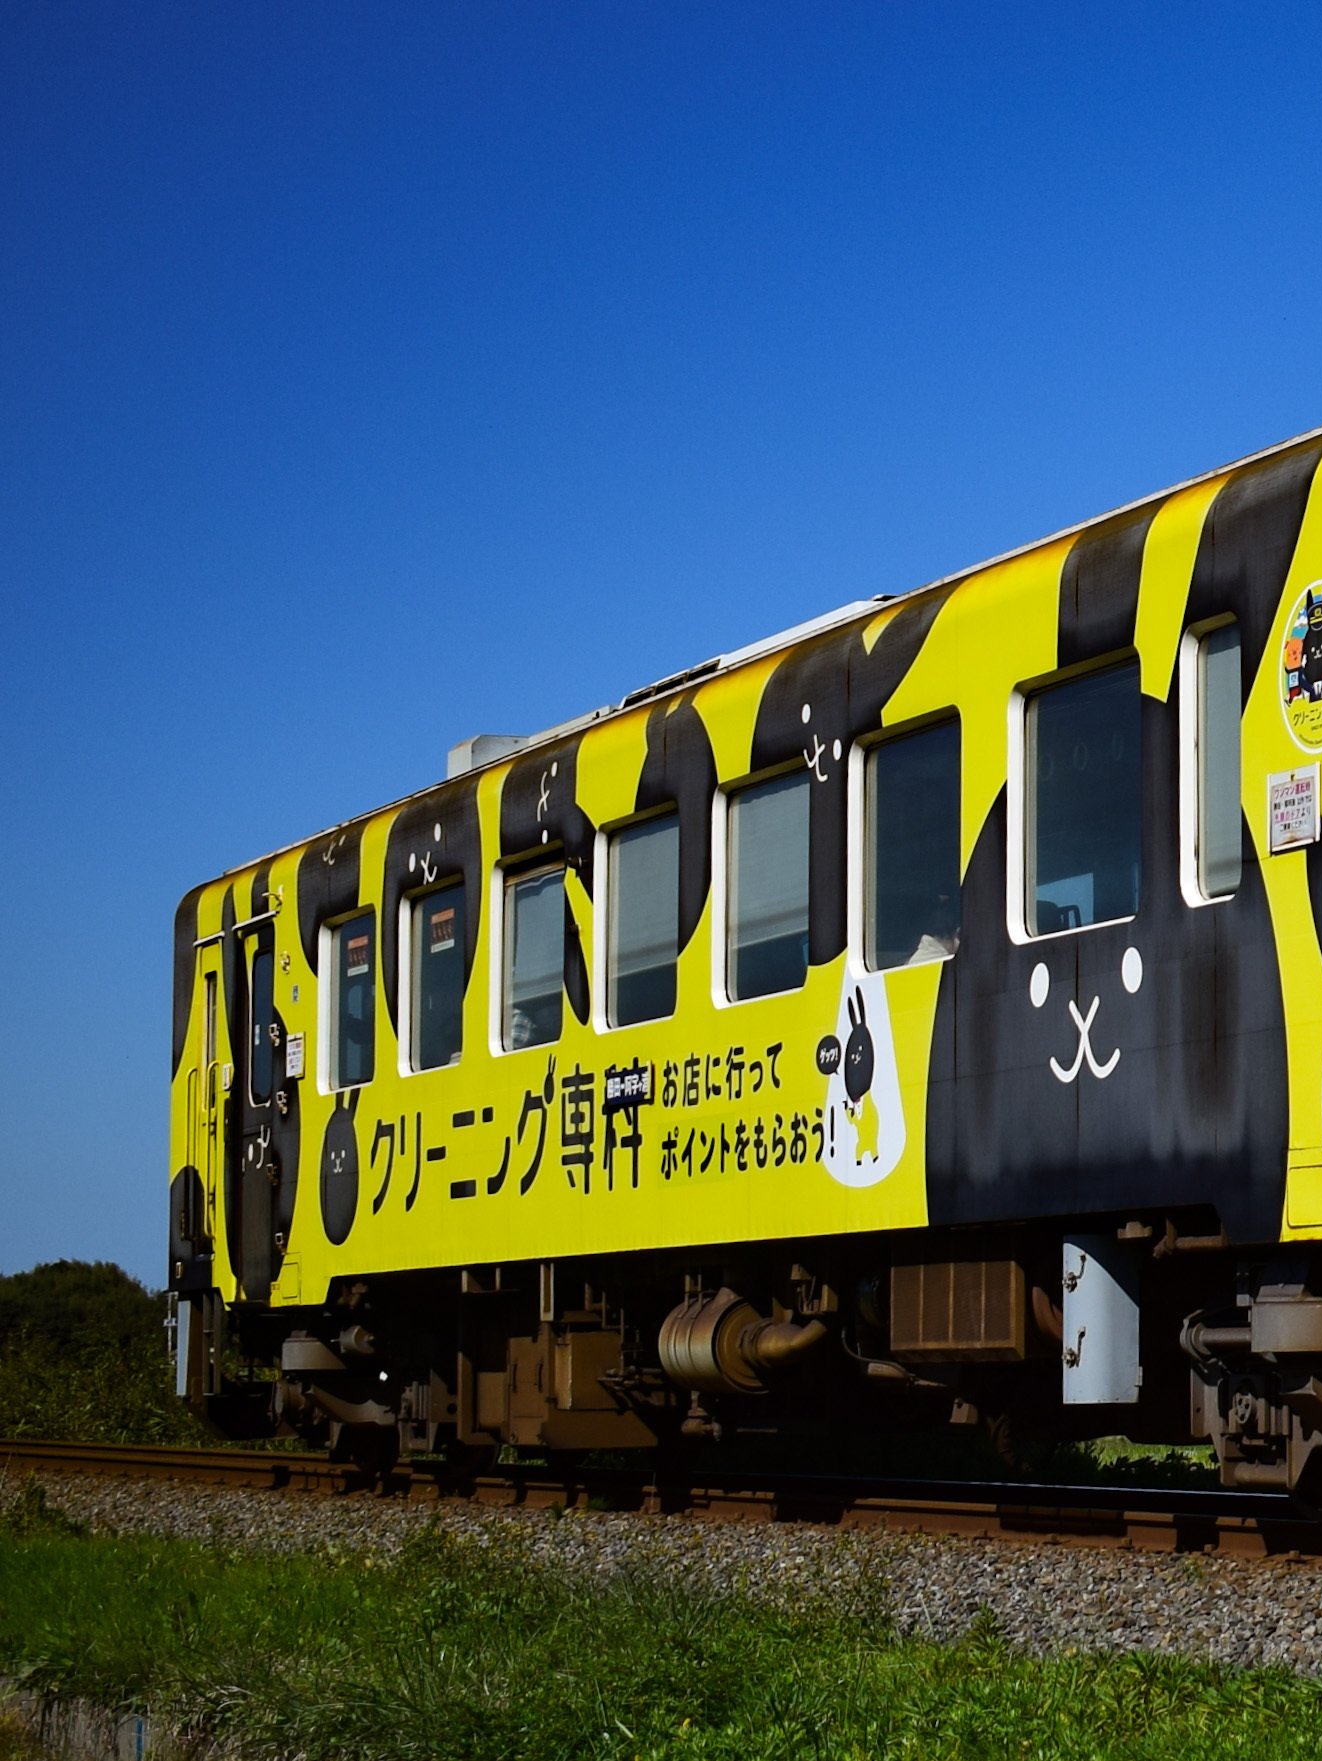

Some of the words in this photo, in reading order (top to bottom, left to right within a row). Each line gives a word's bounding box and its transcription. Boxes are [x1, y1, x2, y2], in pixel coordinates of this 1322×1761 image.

[662, 1042, 784, 1108] お店に行って
[661, 1107, 836, 1181] ポイントをもらおう!
